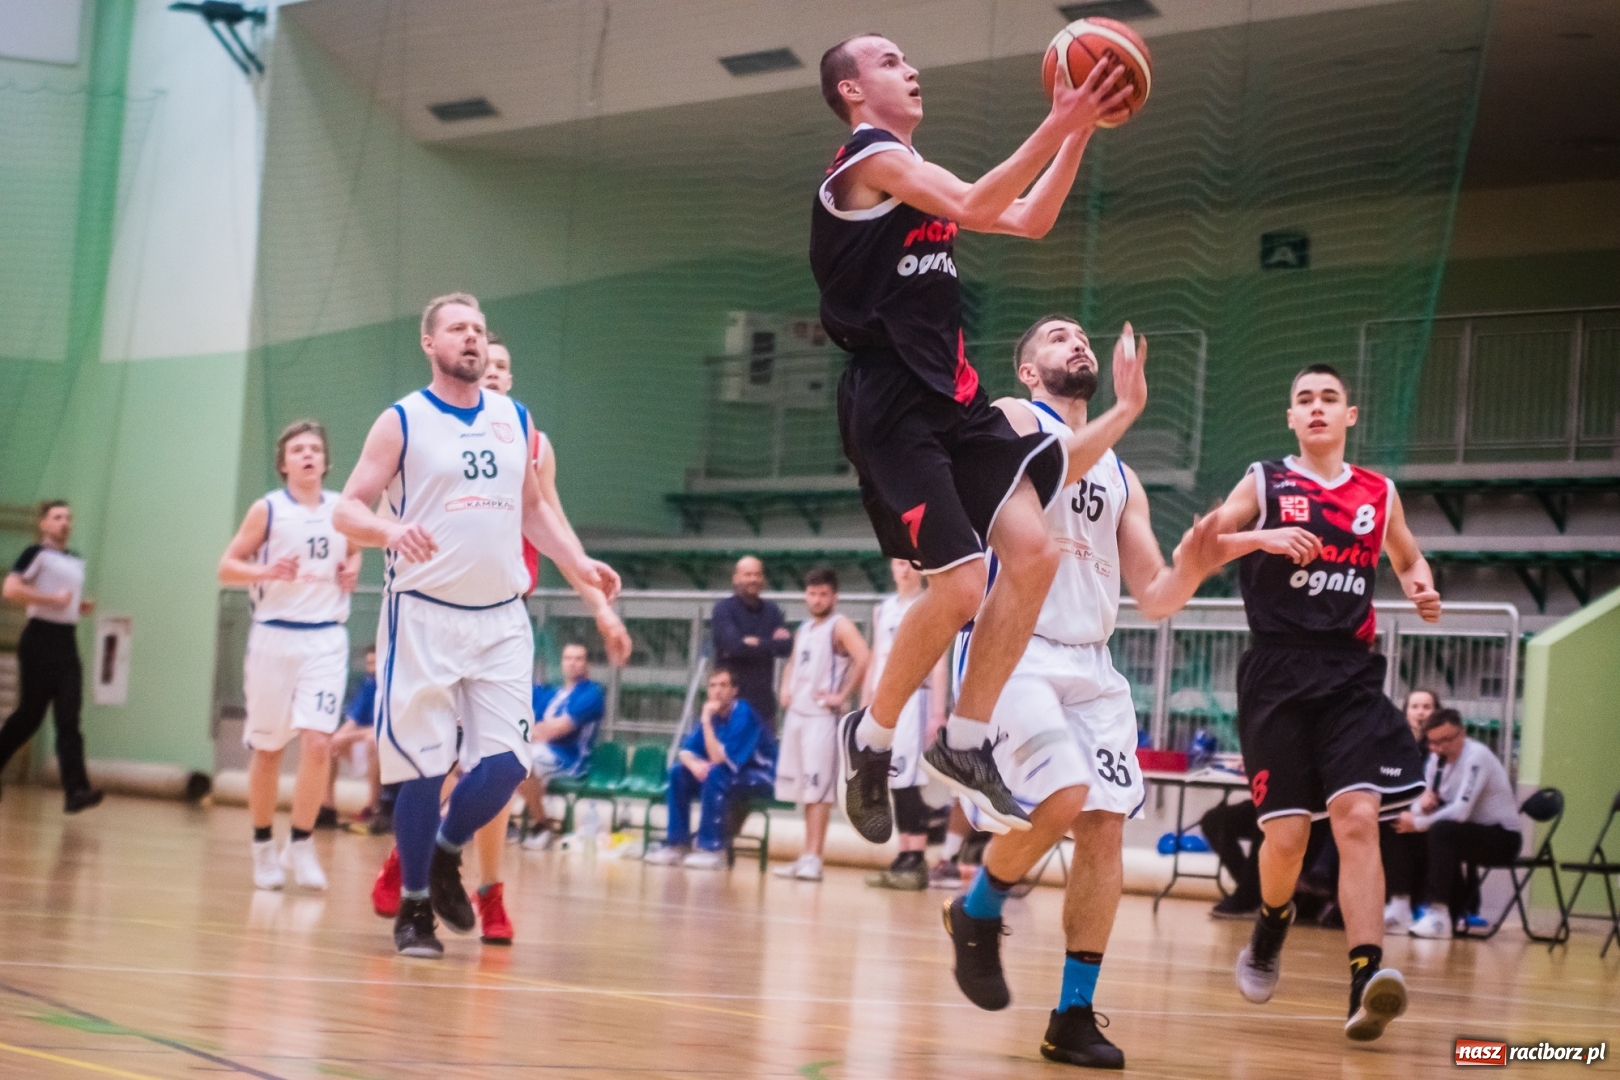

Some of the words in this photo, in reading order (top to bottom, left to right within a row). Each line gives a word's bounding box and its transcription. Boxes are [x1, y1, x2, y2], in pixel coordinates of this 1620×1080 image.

[462, 450, 498, 480] 33
[1071, 478, 1107, 522] 35
[1351, 503, 1377, 535] 8
[307, 537, 329, 559] 13
[1289, 567, 1366, 596] ognia
[314, 691, 336, 715] 13
[1096, 748, 1132, 788] 35
[1252, 770, 1270, 807] 8
